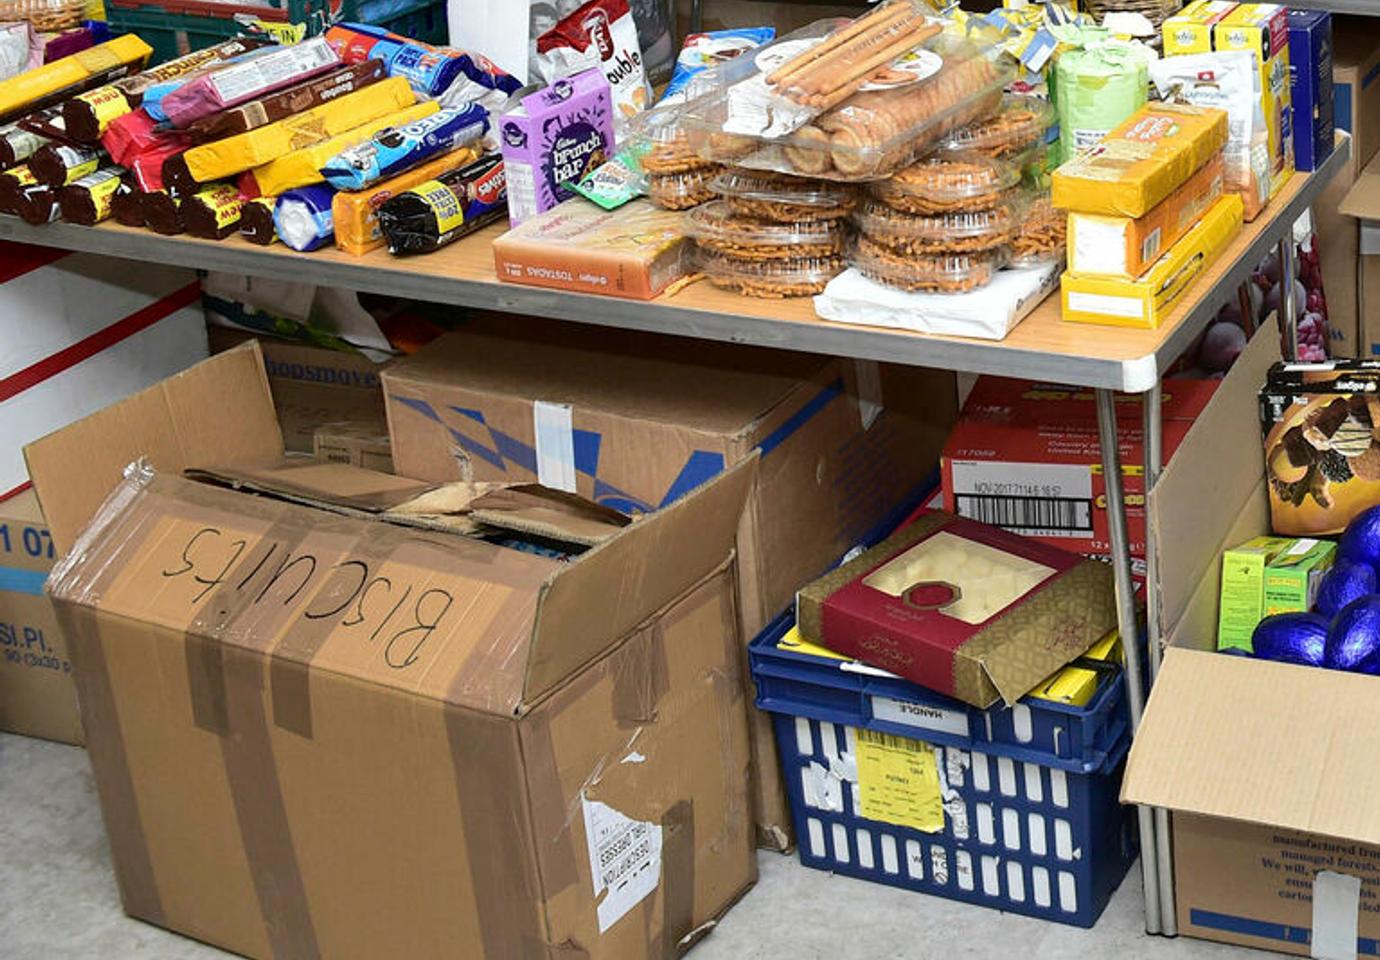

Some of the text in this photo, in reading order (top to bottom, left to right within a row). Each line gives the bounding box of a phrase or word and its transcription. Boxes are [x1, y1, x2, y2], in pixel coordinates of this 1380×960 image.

[606, 49, 641, 85] ouble
[553, 132, 601, 165] brunch
[552, 158, 584, 184] bar
[1262, 857, 1281, 870] We
